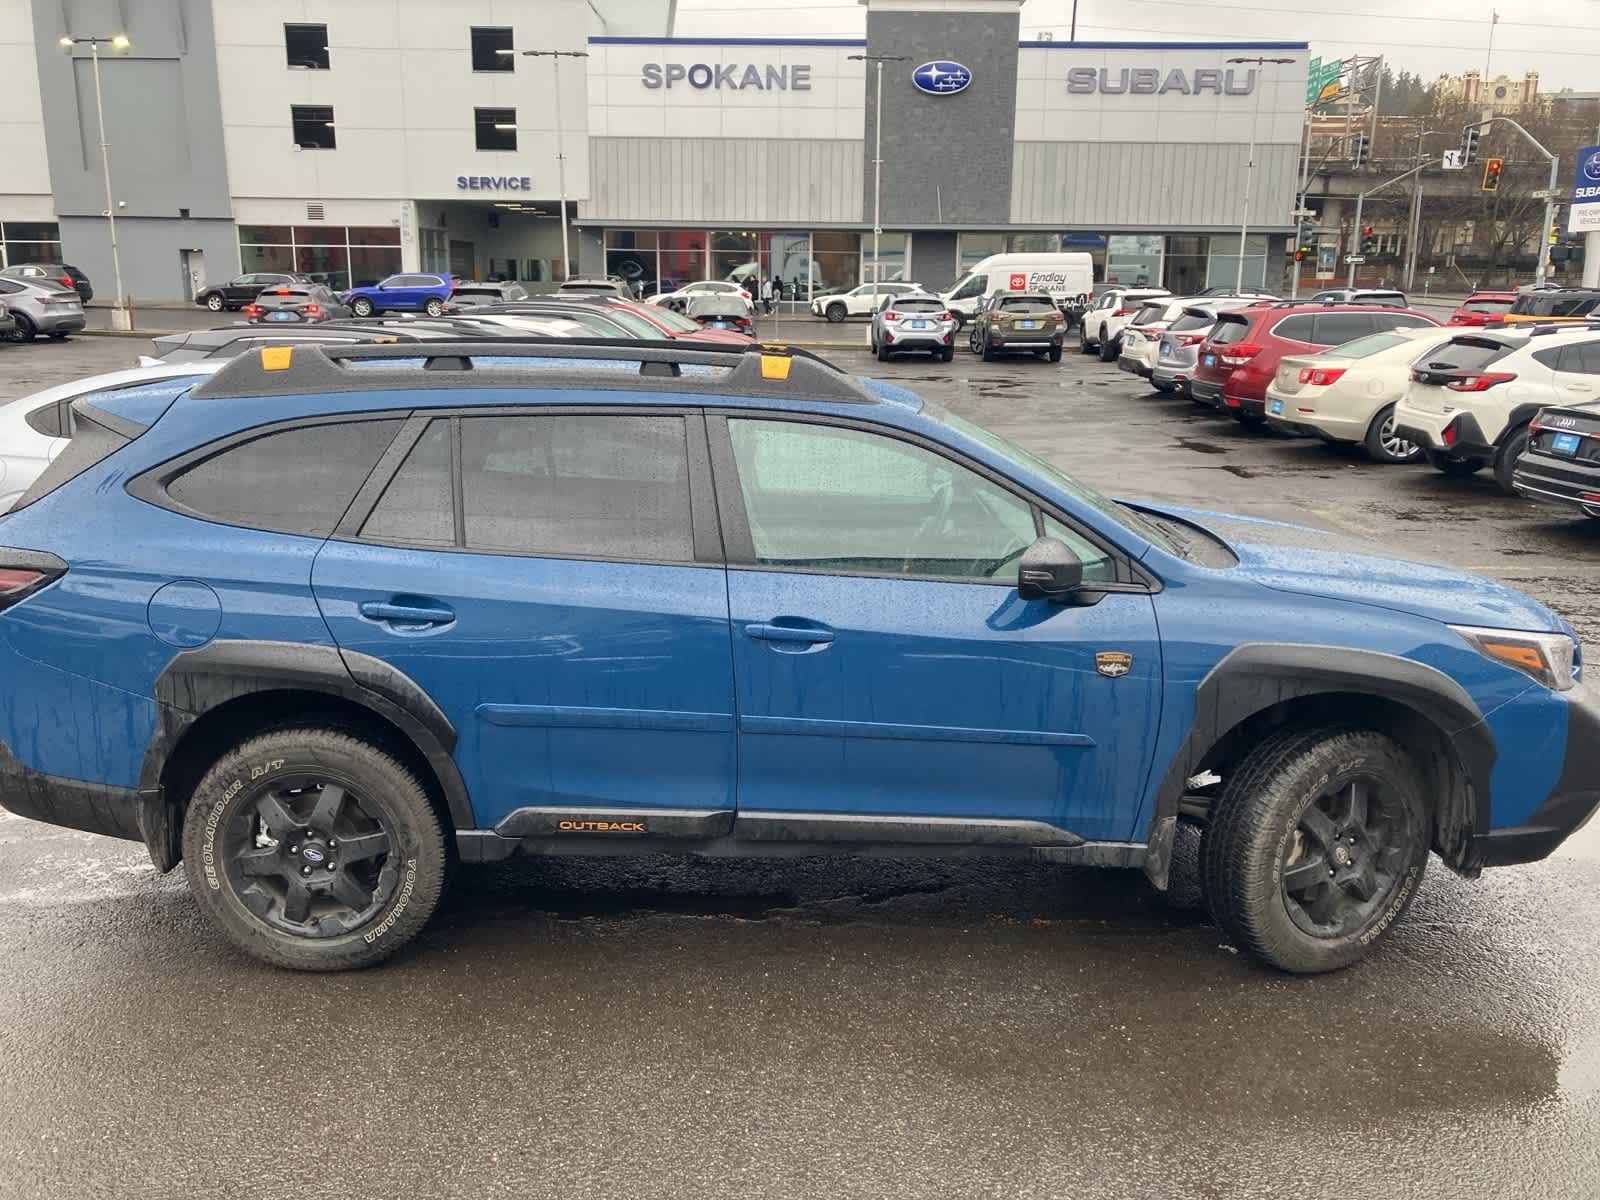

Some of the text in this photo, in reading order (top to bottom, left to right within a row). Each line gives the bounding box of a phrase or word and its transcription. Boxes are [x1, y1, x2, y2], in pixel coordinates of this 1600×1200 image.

[641, 63, 811, 90] SPOKANE
[1067, 67, 1256, 95] SUBARU
[457, 176, 531, 190] SERVICE
[1030, 272, 1067, 284] Findlay
[203, 759, 285, 890] GEOLANDAR A/T
[559, 821, 645, 832] OUTBACK
[363, 858, 417, 943] YOKOHAMA
[1360, 866, 1418, 944] YOKOHAMA
